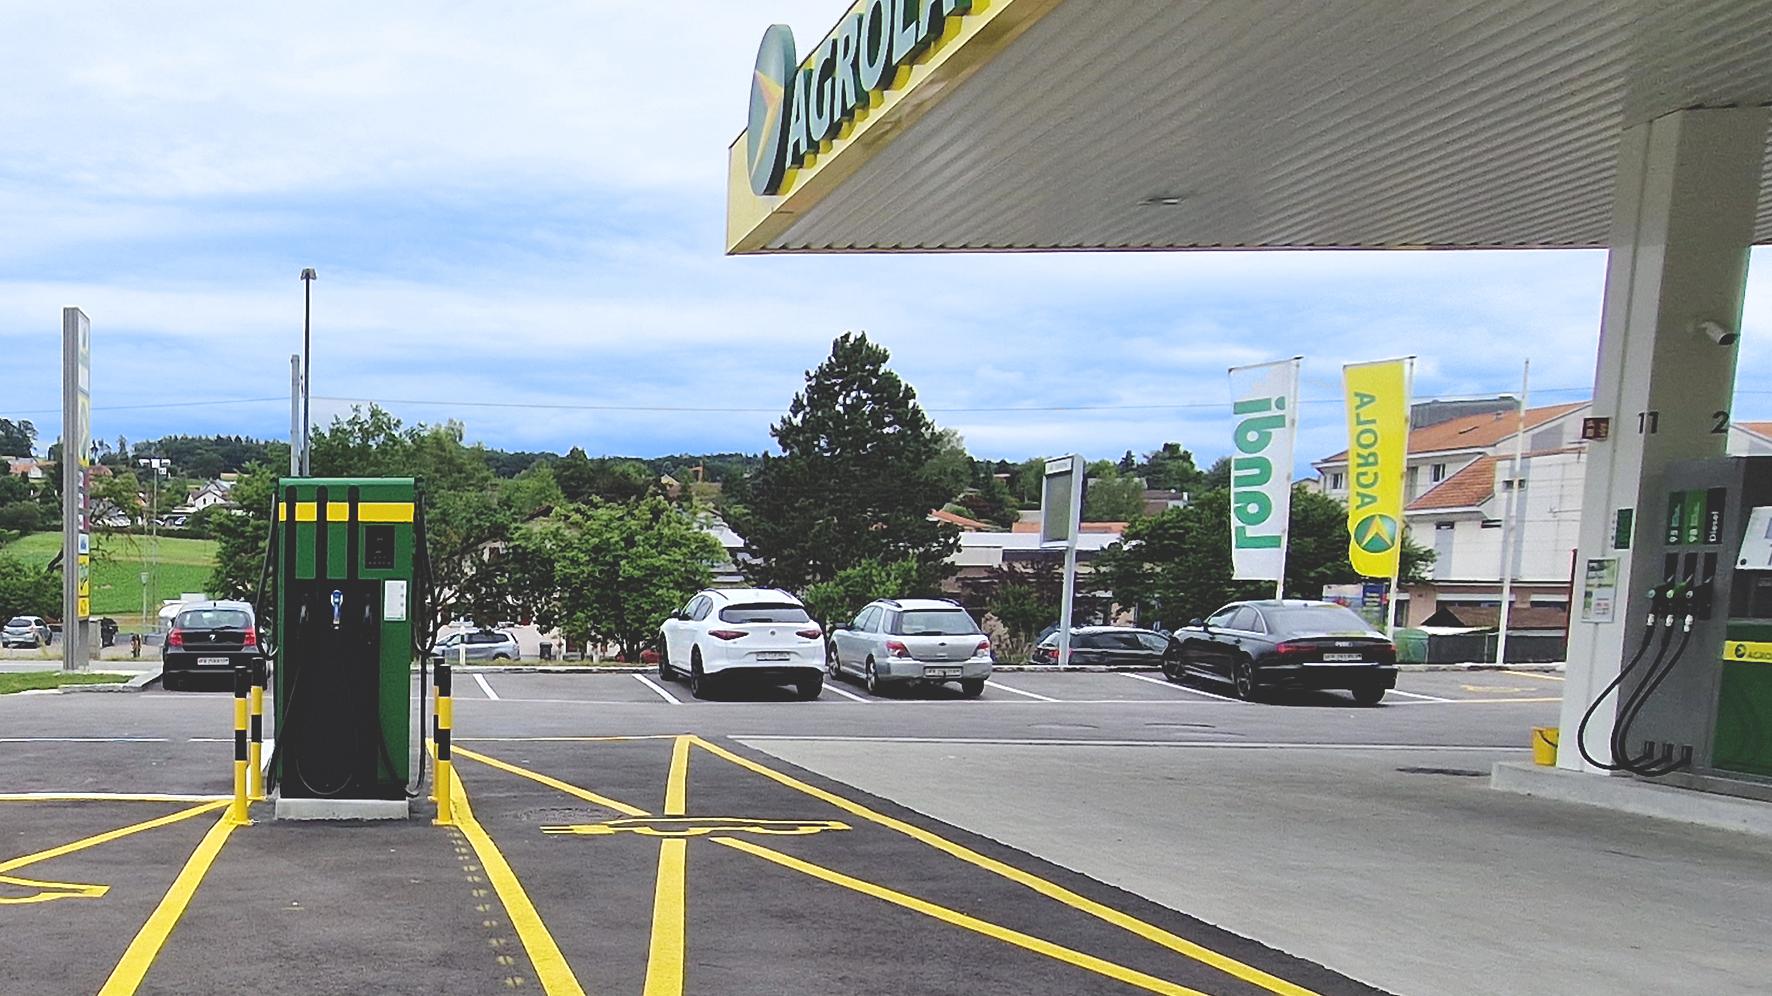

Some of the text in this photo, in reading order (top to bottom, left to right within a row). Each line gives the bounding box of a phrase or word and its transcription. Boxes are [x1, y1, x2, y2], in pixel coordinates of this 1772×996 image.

[786, 0, 956, 169] AGROL
[1711, 410, 1730, 434] 2
[1709, 511, 1719, 542] Diesel
